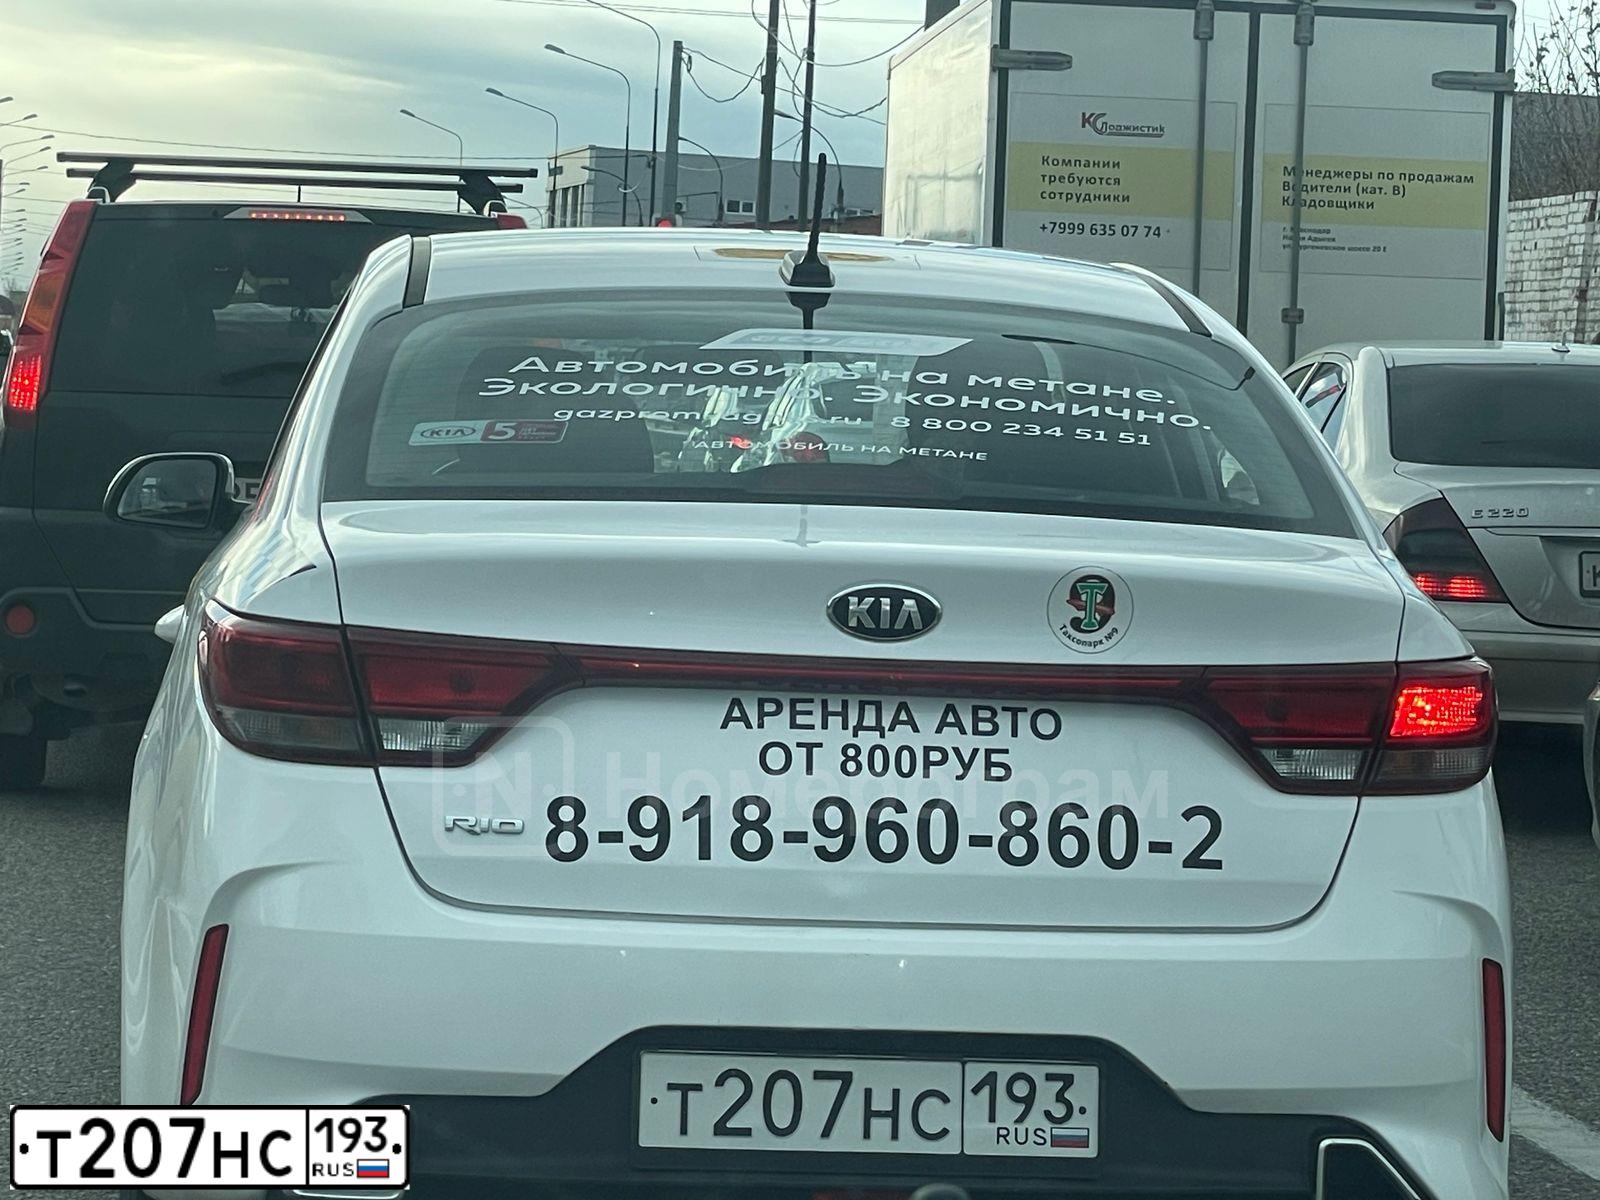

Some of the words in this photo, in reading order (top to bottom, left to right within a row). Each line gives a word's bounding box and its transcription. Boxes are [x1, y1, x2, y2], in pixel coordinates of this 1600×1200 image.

[1041, 155, 1121, 169] Компании
[1040, 173, 1121, 187] требуются
[1283, 166, 1373, 181] Мнеджеры
[1377, 171, 1394, 181] по
[1399, 172, 1474, 183] продажам
[1040, 190, 1130, 203] сотрудники
[1356, 182, 1388, 197] (кат.
[1392, 184, 1406, 198] В)
[1282, 196, 1374, 211] Кадовщики
[1040, 222, 1085, 236] +7999
[1089, 223, 1116, 237] 635
[1121, 224, 1139, 238] 07
[1143, 225, 1161, 239] 74
[508, 356, 862, 380] Автомобиь
[880, 369, 948, 386] на
[967, 372, 1176, 404] метане.
[852, 384, 1211, 430] Экономично.
[429, 428, 466, 437] KIA
[488, 423, 518, 440] 5
[890, 417, 911, 429] 8
[922, 417, 992, 433] 800
[1002, 422, 1064, 438] 234
[1074, 427, 1108, 442] 51
[1117, 430, 1151, 446] 51
[694, 440, 854, 452] АВТОМОБИЛЬ
[861, 445, 891, 454] НА
[899, 447, 988, 461] МЕТАНЕ
[847, 596, 924, 630] KIA
[1059, 623, 1105, 649] Таксопарк
[719, 696, 920, 739] АРЕНДА
[934, 702, 1063, 741] АВТО
[758, 740, 824, 776] ОТ
[839, 742, 1013, 782] 800РУБ
[444, 814, 525, 836] RIO
[545, 794, 1223, 871] 8-918-960-860-2
[666, 1067, 952, 1143] Т207НС
[970, 1069, 1076, 1125] 193
[996, 1126, 1048, 1146] RUS
